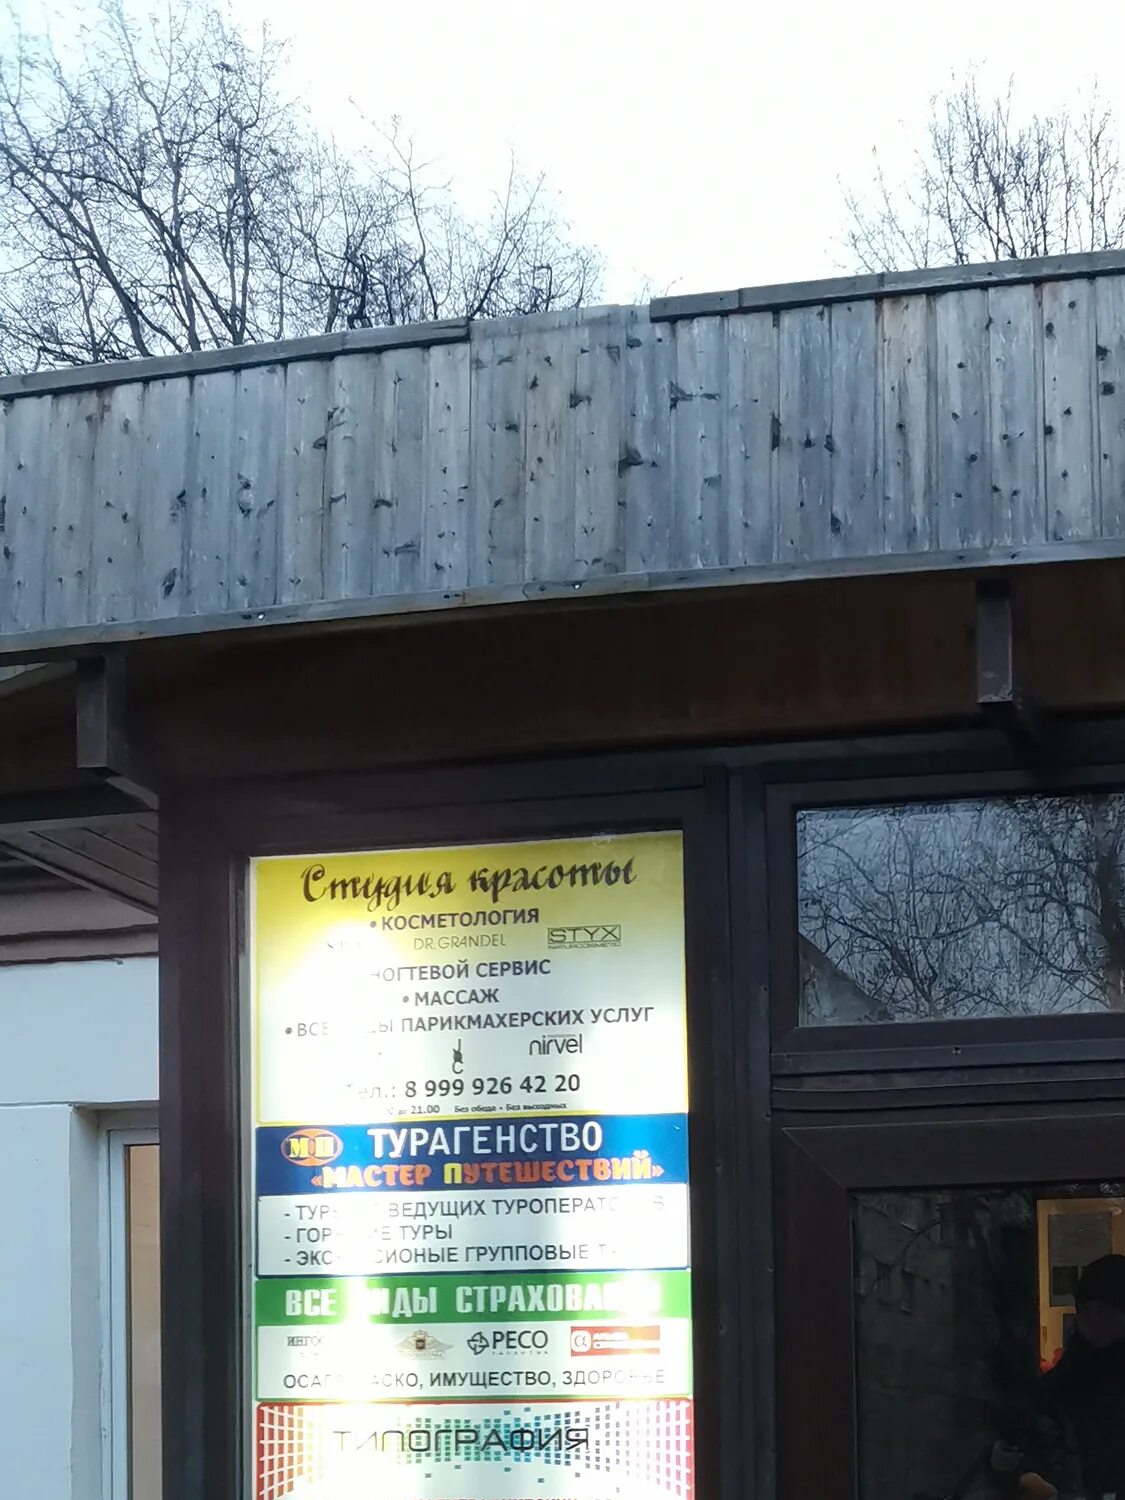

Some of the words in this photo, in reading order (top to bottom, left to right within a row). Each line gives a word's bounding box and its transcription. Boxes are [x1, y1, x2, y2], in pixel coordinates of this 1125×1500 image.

[300, 863, 456, 912] Студия
[467, 857, 639, 904] красоты
[382, 908, 540, 931] КОСМЕТОЛОГИЯ
[549, 926, 619, 944] STYX
[475, 958, 551, 979] СЕРВИС
[414, 988, 500, 1006] МАССАЖ
[297, 1021, 329, 1037] ВСЕ
[402, 1009, 584, 1033] ПАРИКМАХЕРСКИХ
[590, 1007, 655, 1025] УСЛУГ
[529, 1033, 583, 1056] nirvel
[404, 1081, 417, 1098] 8
[424, 1078, 465, 1097] 999
[471, 1076, 513, 1095] 926
[519, 1075, 547, 1094] 42
[554, 1073, 581, 1092] 20
[410, 1104, 441, 1114] 21.00
[366, 1121, 603, 1158] ТУРАГЕНСТВО
[311, 1163, 432, 1189] «МАСТЕР
[444, 1150, 664, 1185] ПУТЕШЕСТВИЙ»
[388, 1200, 486, 1222] ВЕДУЩИХ
[400, 1224, 453, 1243] ТУРЫ
[465, 1243, 589, 1263] ГРУППОВЫЕ
[285, 1288, 337, 1316] ВСЕ
[362, 1286, 438, 1318] ИДЫ
[492, 1330, 548, 1349] РЕСО
[429, 1370, 557, 1390] ИМУЩЕСТВО,
[333, 1427, 589, 1453] ТИПОГРАФИЯ
